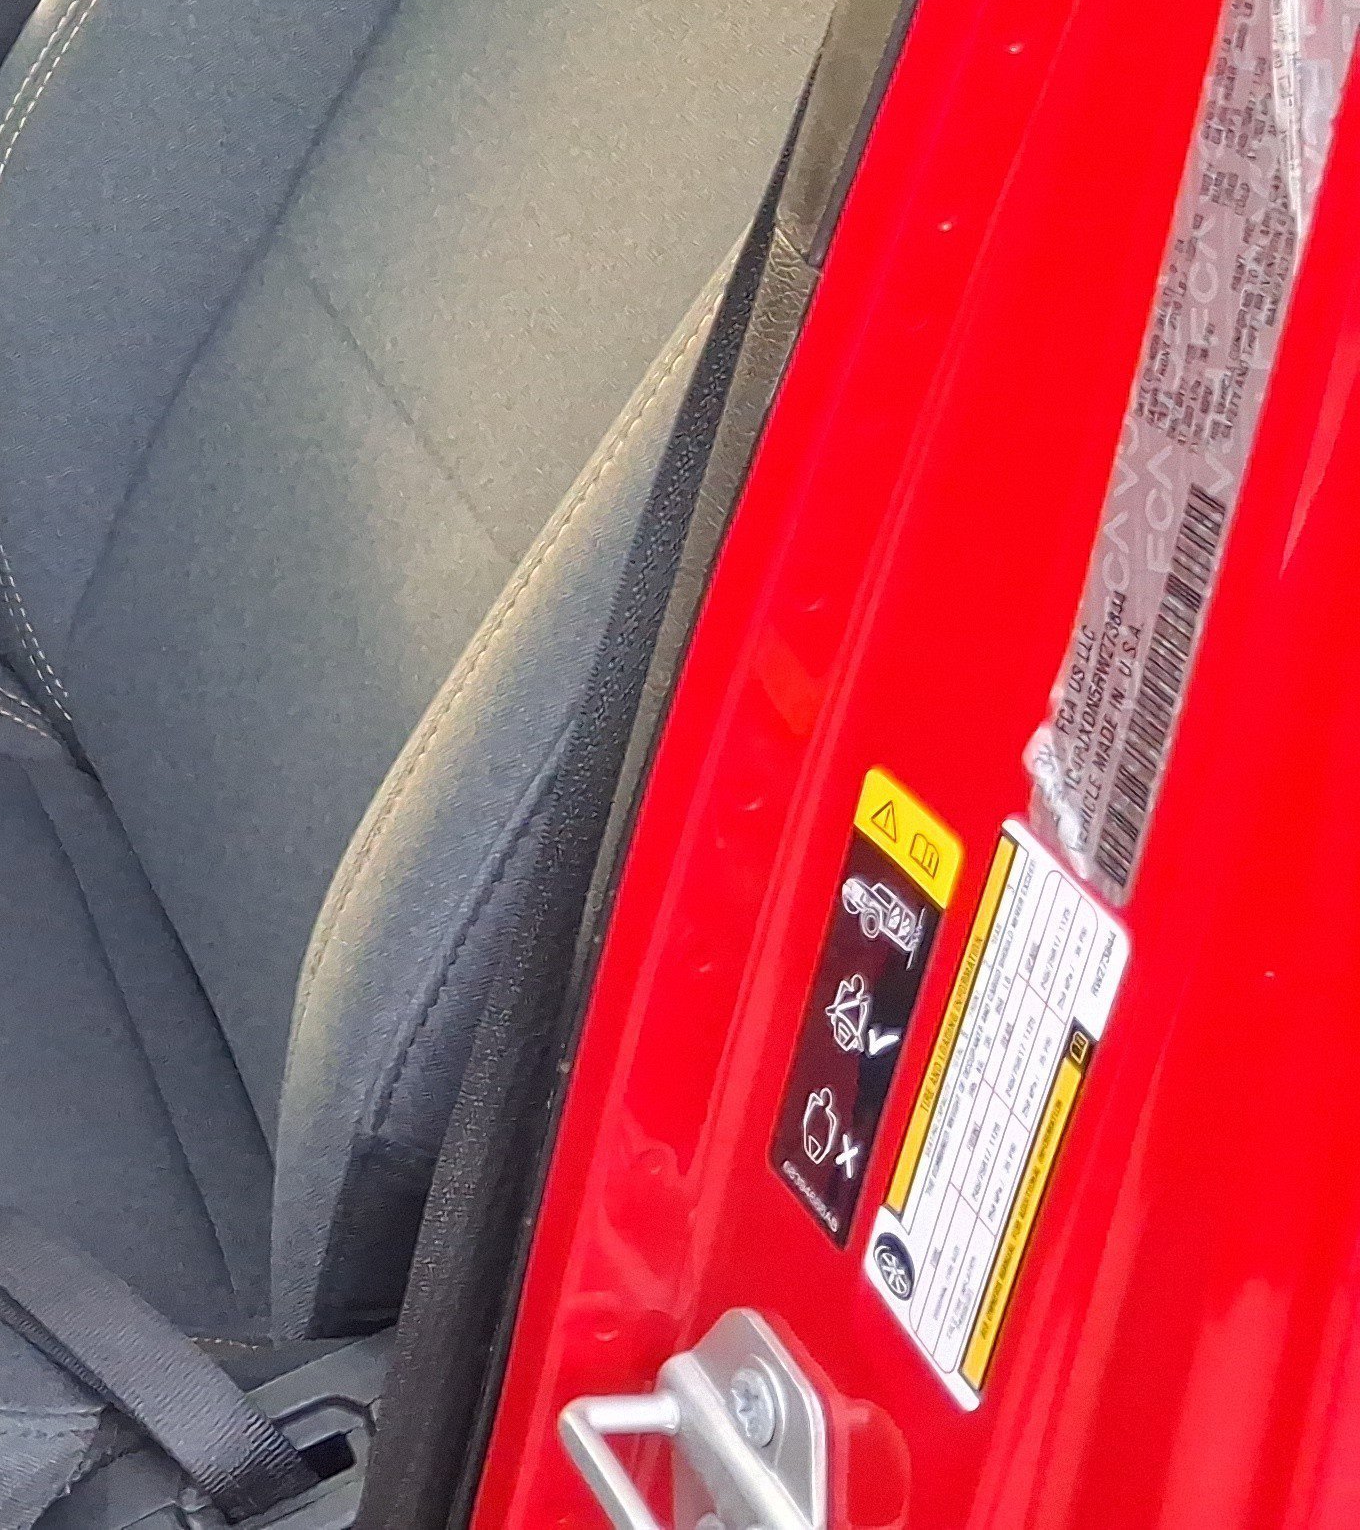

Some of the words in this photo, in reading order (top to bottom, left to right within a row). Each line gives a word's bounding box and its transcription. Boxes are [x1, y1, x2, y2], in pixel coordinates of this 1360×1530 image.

[1077, 625, 1095, 665] LLC
[1069, 665, 1086, 693] US
[1056, 699, 1076, 735] FCA
[1092, 716, 1119, 772] MADE
